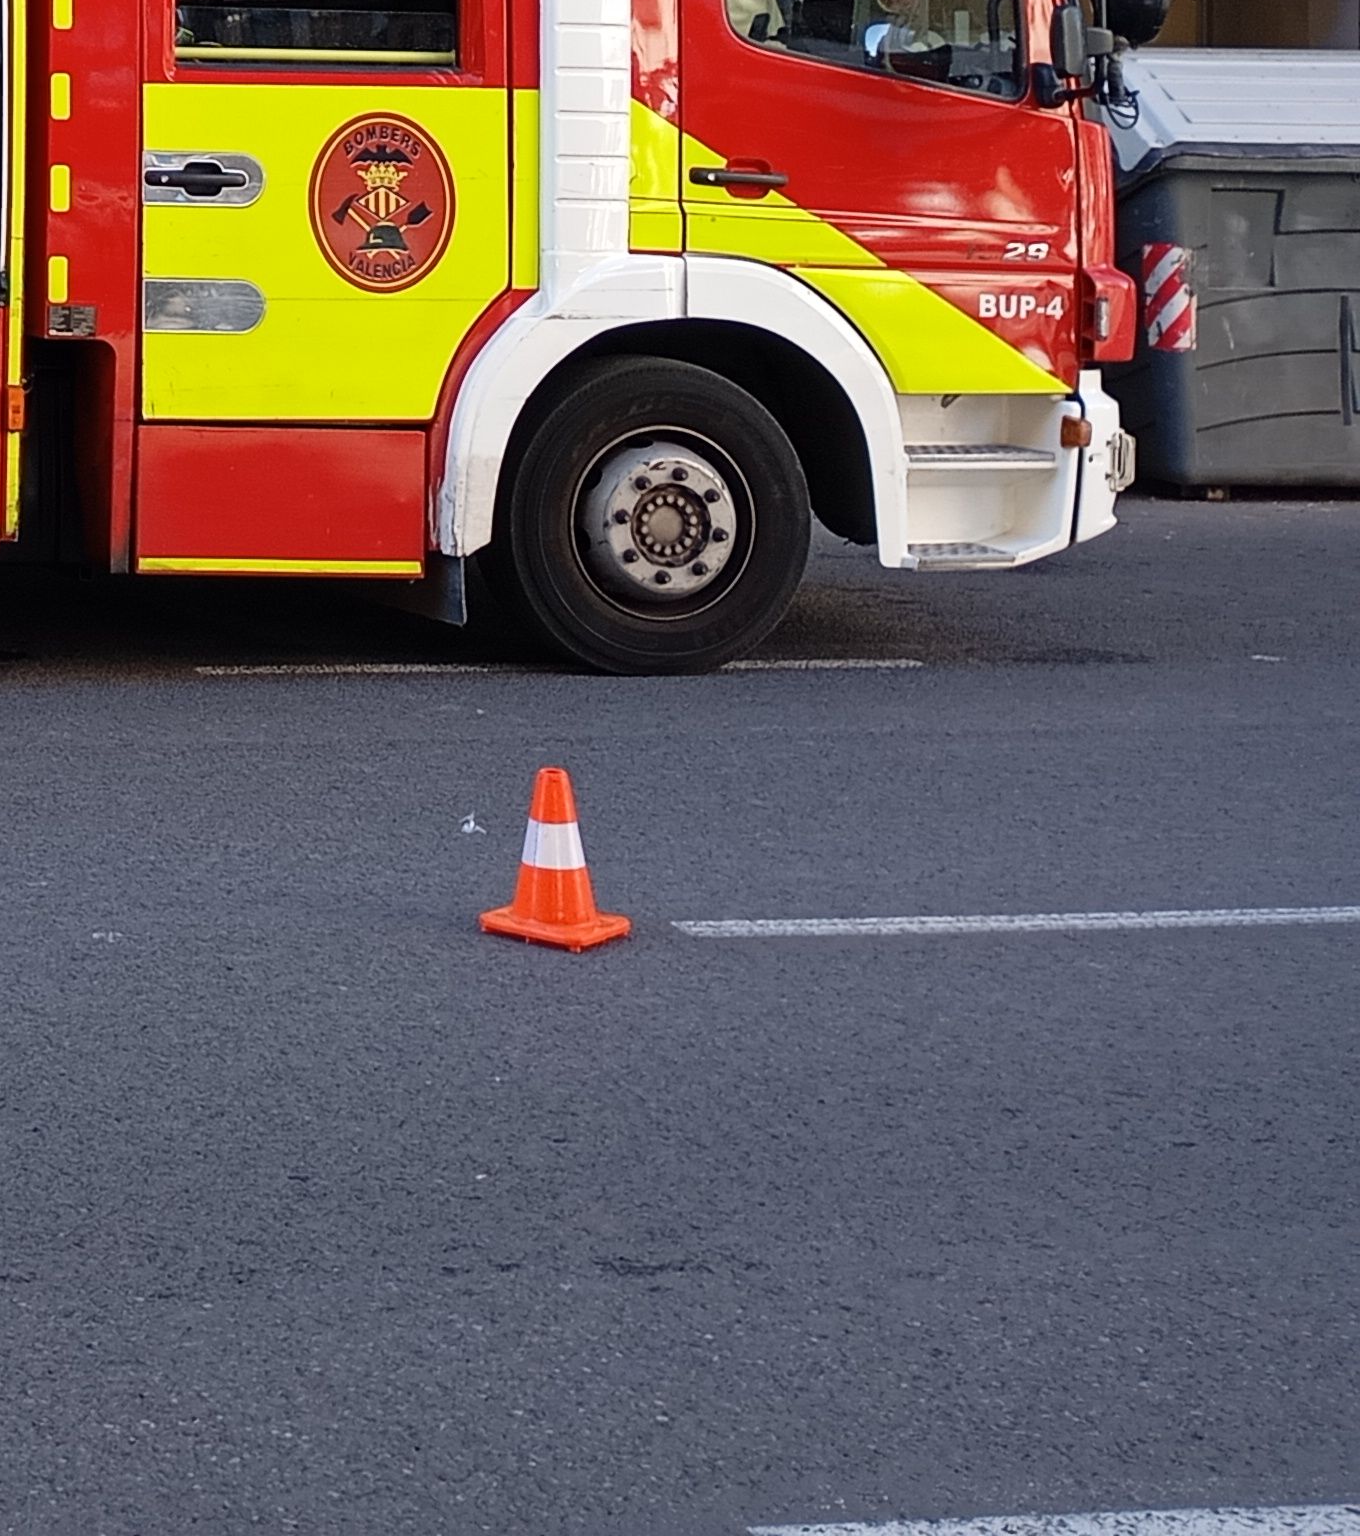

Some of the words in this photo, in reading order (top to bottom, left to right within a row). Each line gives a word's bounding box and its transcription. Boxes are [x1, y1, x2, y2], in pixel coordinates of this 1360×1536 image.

[343, 125, 421, 159] BOMBERS
[347, 251, 417, 279] VALENCIA
[1002, 241, 1050, 261] 29
[978, 293, 1064, 321] BUP-4
